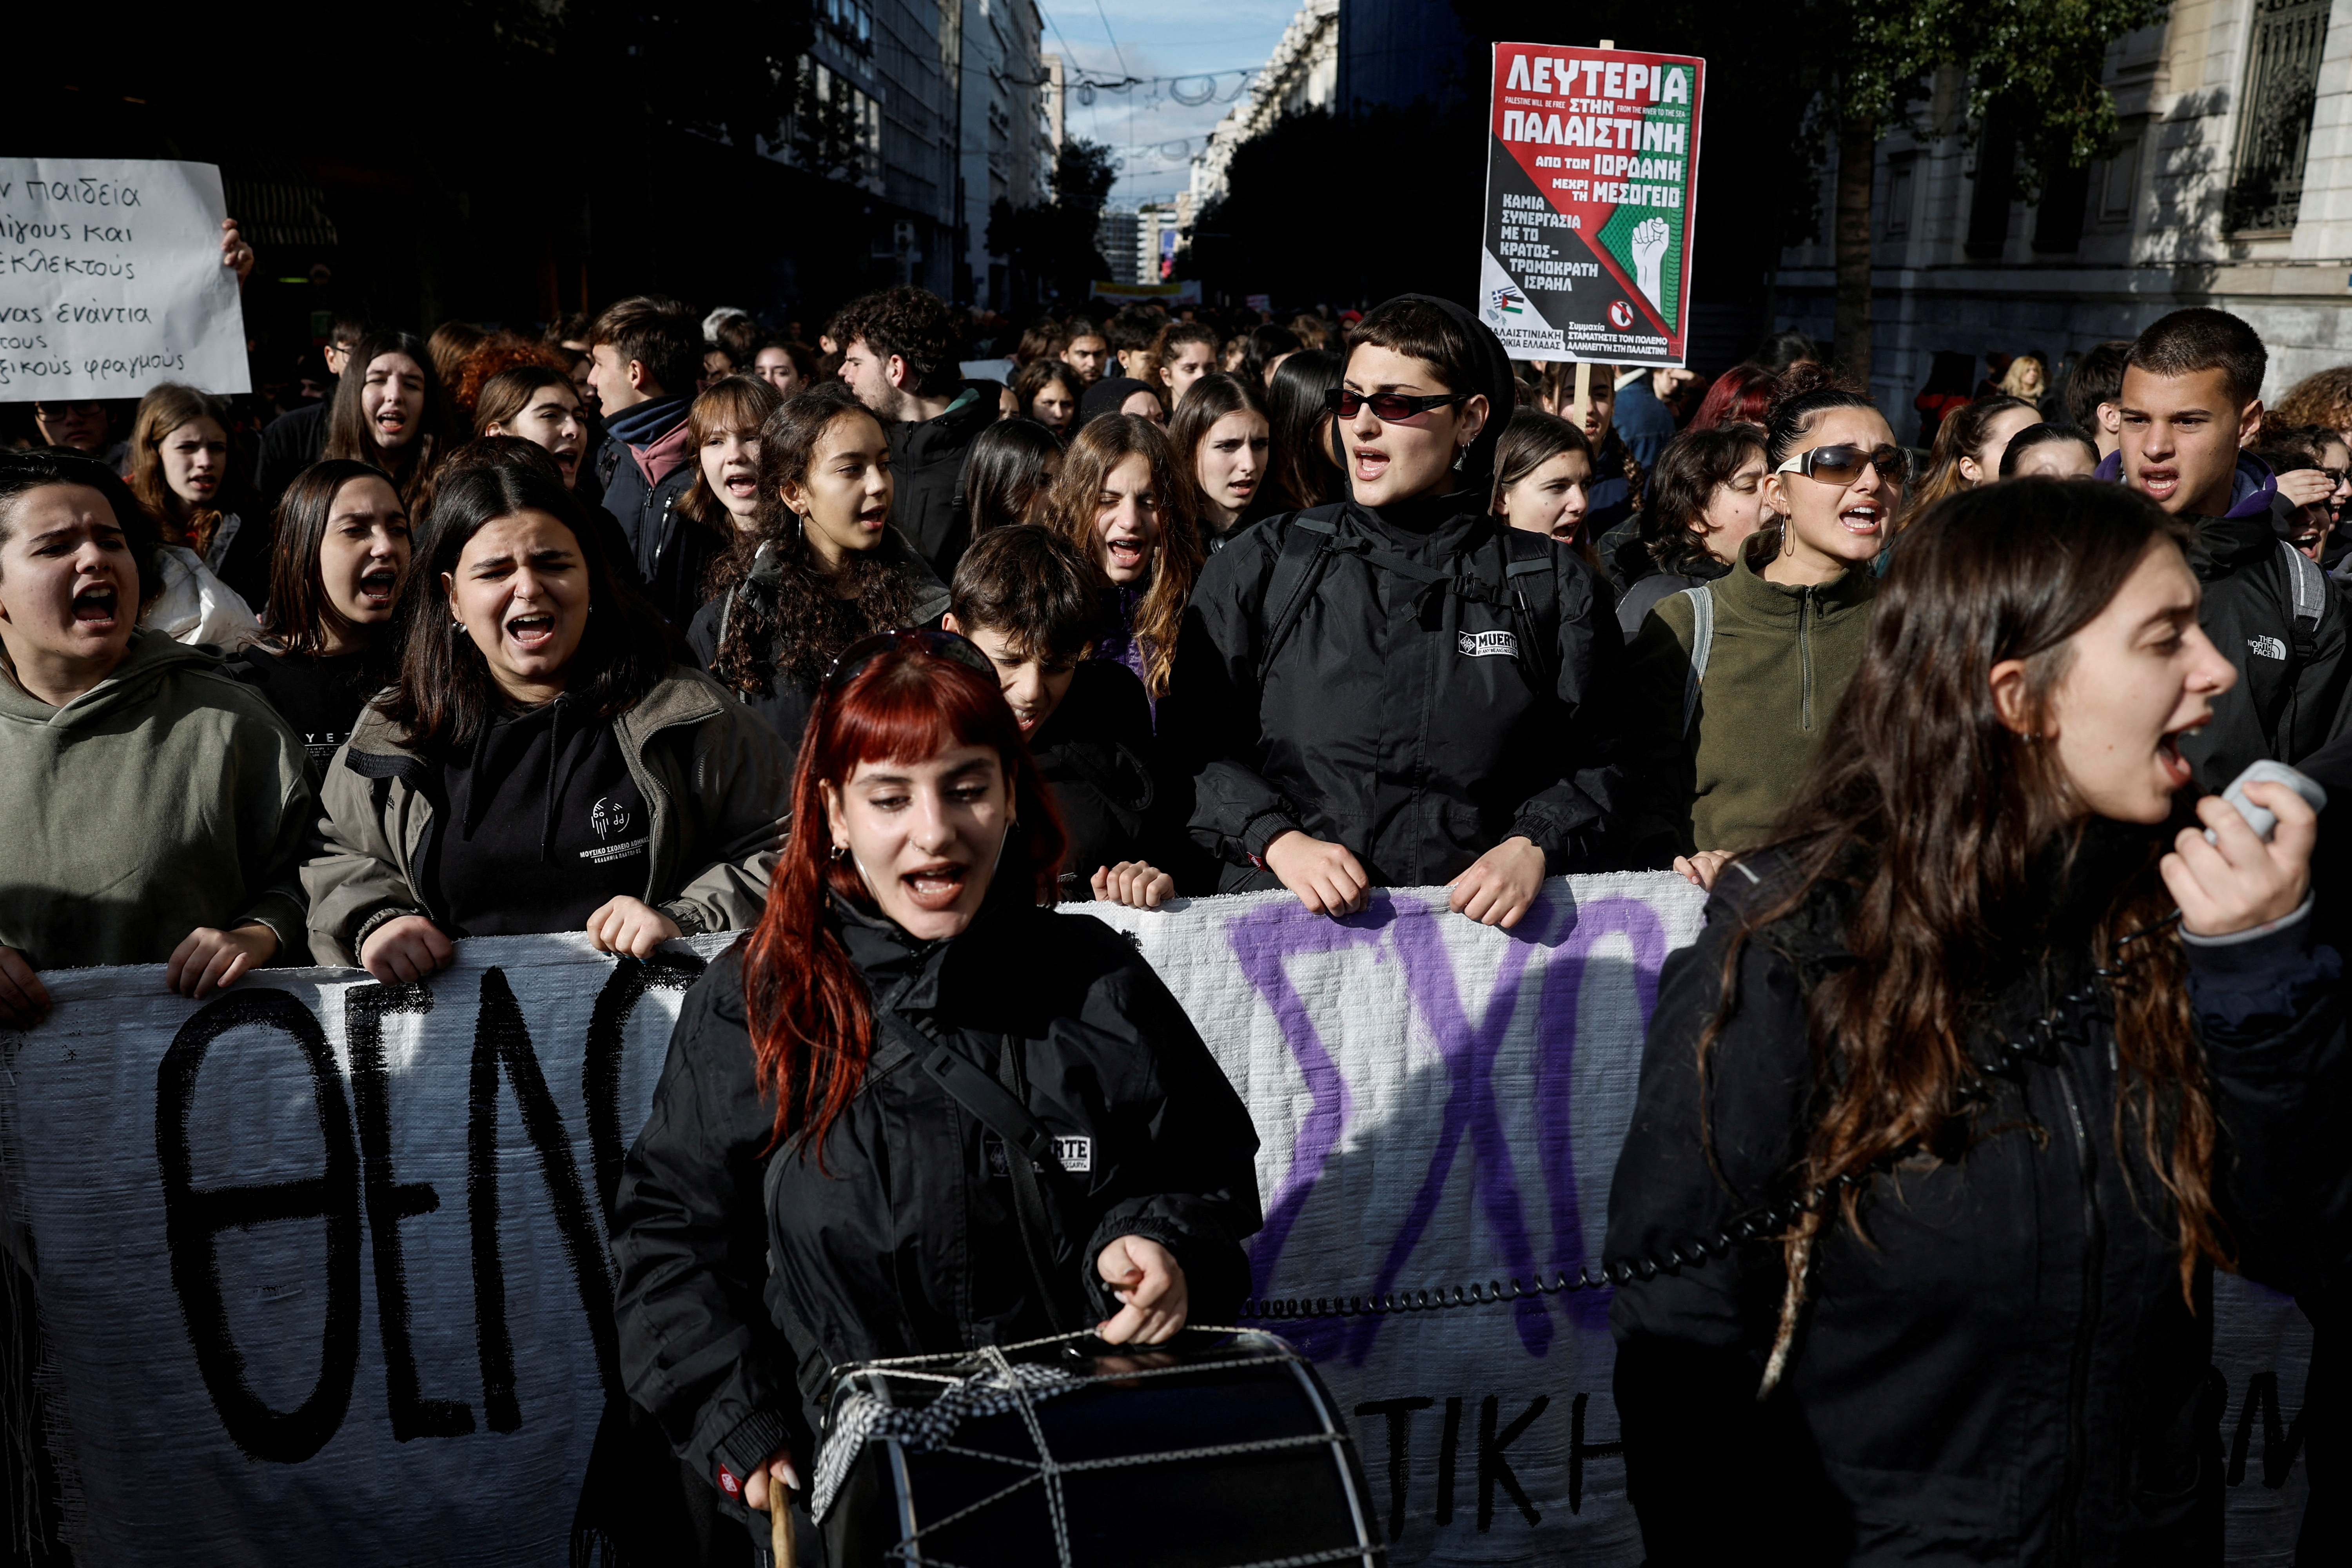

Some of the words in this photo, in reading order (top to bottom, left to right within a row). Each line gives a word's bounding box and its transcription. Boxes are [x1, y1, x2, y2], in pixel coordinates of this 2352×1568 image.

[1506, 54, 1687, 104] ΛΕΥΤΕΡΙΑ
[1504, 96, 1531, 106] PALESTINE
[1532, 98, 1543, 107] WILL
[1545, 100, 1552, 108] BE
[1552, 100, 1566, 109] FREE
[1569, 98, 1615, 114] ΣΤΗΝ
[1617, 105, 1632, 113] FROM
[1632, 106, 1642, 114] THE
[1642, 107, 1657, 115] RIVER
[1658, 108, 1665, 116] TO
[1503, 110, 1686, 154] ΠΑΛΑΙΣΤΙΝΗ
[1535, 156, 1561, 168] ΑΠΟ
[1564, 158, 1590, 170] ΤΟΝ
[1594, 154, 1682, 181] ΙΟΡΔΑΝΗ
[1552, 178, 1589, 189] ΜΕΧΡΙ
[26, 178, 142, 207] παιδεία
[1572, 191, 1588, 202] ΤΗ
[1592, 181, 1680, 208] ΜΕΣΟΓΕΙΟ
[1503, 194, 1545, 211] ΚΑΜΙΑ
[1501, 209, 1581, 229] ΣΥΝΕΡΓΑΣΙΑ
[84, 224, 132, 243] και
[1501, 226, 1520, 240] ΜΕ
[1522, 228, 1539, 241] ΤΟ
[1510, 258, 1599, 278] ΤΡΟΜΟΚΡΑΤΗ
[1524, 276, 1572, 292] ΙΣΡΑΗΛ
[56, 297, 152, 324] ενάντια
[1489, 327, 1561, 339] ΑΛΑΙΣΤΙΝΙΑΚΗ
[1568, 321, 1605, 332] Συμμαχία
[0, 334, 47, 350] τους
[1499, 338, 1521, 347] ΟΙΚΙΑ
[1523, 340, 1561, 350] ΕΛΛΑΔΑΣ
[1568, 332, 1617, 342] ΣΤΑΜΑΤΗΣΤΕ
[1618, 334, 1635, 343] ΤΟΝ
[1635, 336, 1668, 345] ΠΟΛΕΜΟ
[1567, 342, 1612, 352] ΑΛΛΗΛΕΓΓΥΗ
[1613, 345, 1626, 353] ΣΤΗ
[1626, 345, 1667, 356] ΠΑΛΑΙΣΤΙΝΗ
[84, 347, 184, 381] φραγμούς
[2247, 639, 2272, 650] NORTH
[2258, 635, 2273, 644] THE
[2253, 648, 2272, 658] FACE
[579, 847, 606, 858] ΜΟΥΣΙΚΟ
[606, 842, 630, 853] ΣΧΟΛΕΙΟ
[630, 836, 650, 847] ΑΘΗΝΑΣ
[594, 854, 618, 864] ΑΚΑΔΗΜΙΑ
[1051, 1140, 1087, 1158] RTE
[1062, 1161, 1087, 1169] SSARY.
